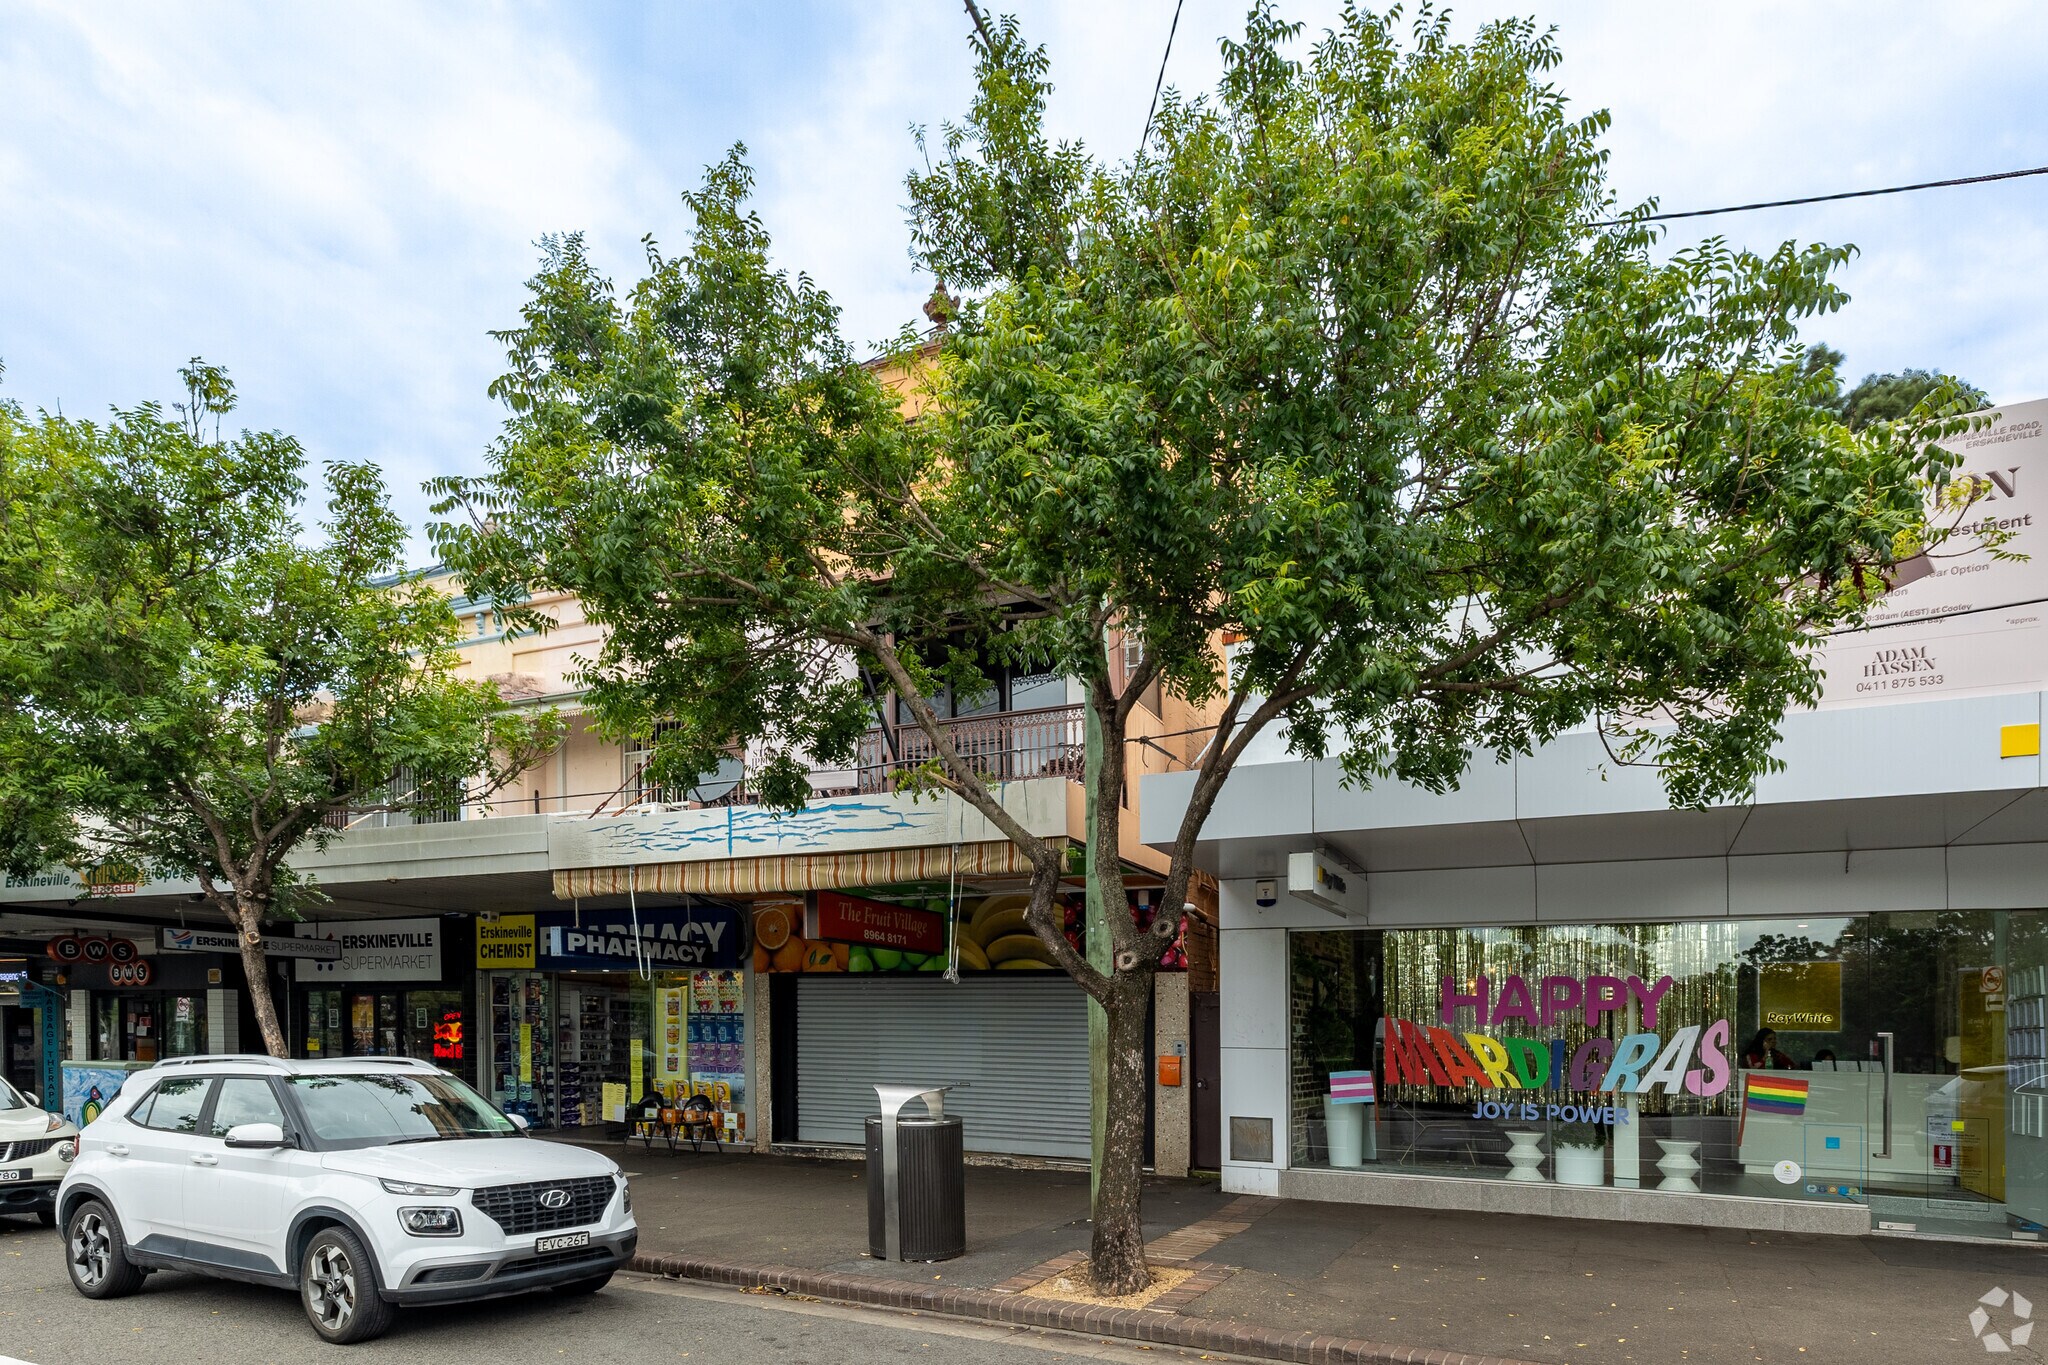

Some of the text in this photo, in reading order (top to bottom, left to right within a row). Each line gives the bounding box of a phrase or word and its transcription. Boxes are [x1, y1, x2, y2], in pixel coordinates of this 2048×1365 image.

[1937, 420, 2043, 445] RSKINEVILLE ROAD,
[1965, 429, 2043, 449] ERSKINEVILLE
[1948, 513, 2032, 538] estment
[1926, 563, 1990, 579] ear Option
[1863, 612, 1899, 622] 0:30am
[1900, 607, 1929, 619] (AEST)
[1930, 606, 1942, 616] at
[1872, 645, 1928, 664] ADAM
[1863, 657, 1938, 678] HASSEN
[1856, 674, 1944, 693] 0411 875 533
[5, 873, 70, 889] Erskineville
[91, 884, 135, 894] GROCER
[839, 901, 928, 939] The Fruit Village
[342, 932, 433, 949] ERSKINEVILLE
[480, 925, 532, 938] Erskineville
[863, 929, 907, 945] 8964 8171
[65, 944, 127, 957] BWS
[196, 936, 337, 955] ERSKINEE SUPERMARKET
[480, 943, 532, 958] CHEMIST
[567, 932, 706, 963] PHARMACY
[342, 954, 433, 971] SUPERMARKET
[113, 967, 144, 978] BWS
[1442, 975, 1673, 1029] HAPPY
[45, 990, 54, 1046] MASSAGE
[433, 1043, 455, 1059] Red
[1384, 1014, 1731, 1097] MARDI GRAS
[47, 1050, 55, 1106] THERAPY
[1472, 1101, 1629, 1126] JOY IS POWER
[0, 1171, 18, 1180] 8Q
